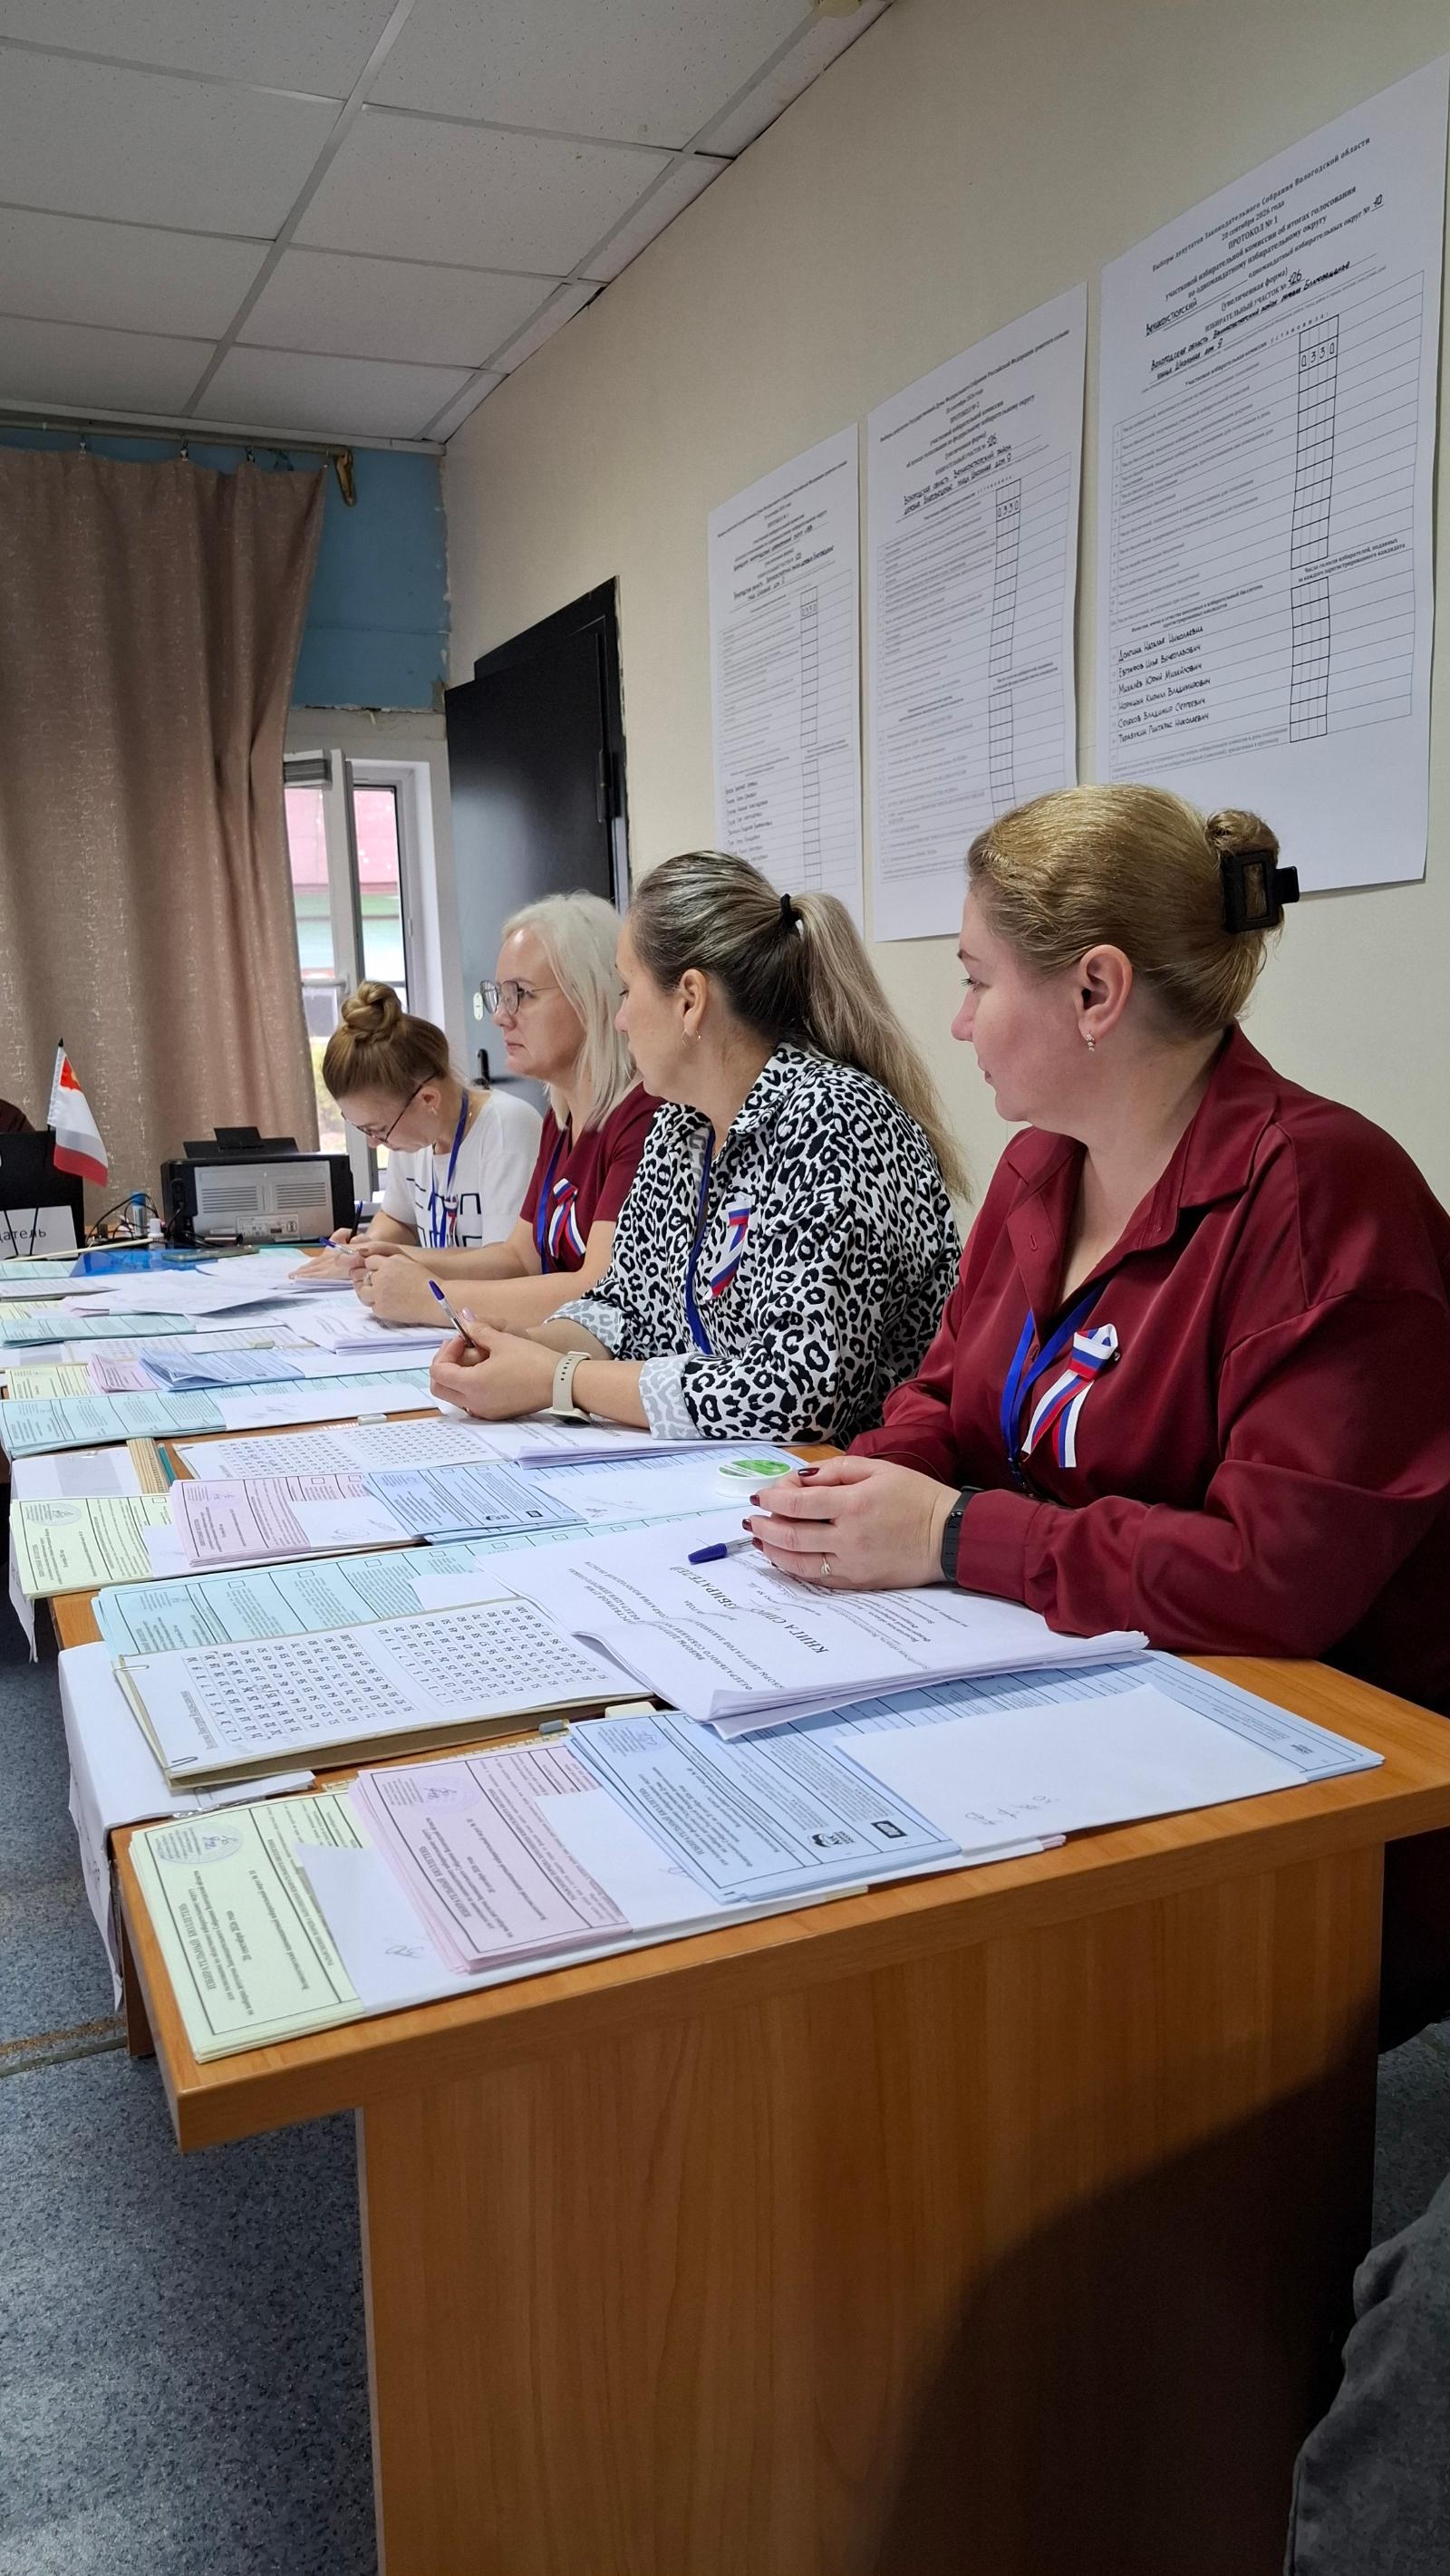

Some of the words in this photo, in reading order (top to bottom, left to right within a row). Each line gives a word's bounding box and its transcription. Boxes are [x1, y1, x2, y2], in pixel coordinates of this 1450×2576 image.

[1165, 274, 1197, 303] участковой
[1197, 246, 1243, 284] избирательной
[1243, 228, 1277, 255] комиссии
[1277, 223, 1286, 236] об
[1286, 210, 1310, 230] итогах
[1310, 184, 1356, 217] голосования
[1227, 221, 1263, 251] ПРОТОКОЛ
[1264, 216, 1272, 229] №
[1273, 213, 1278, 225] 1
[1187, 288, 1195, 299] по
[1195, 258, 1246, 295] одномандатному
[1246, 226, 1301, 267] избирательному
[1301, 213, 1327, 236] округу
[780, 1623, 831, 1654] КНИГА
[177, 1902, 198, 1937] БЮЛЛЕТЕНЬ
[188, 1936, 217, 1991] ИЗБИРАТЕЛЬНЫЙ
